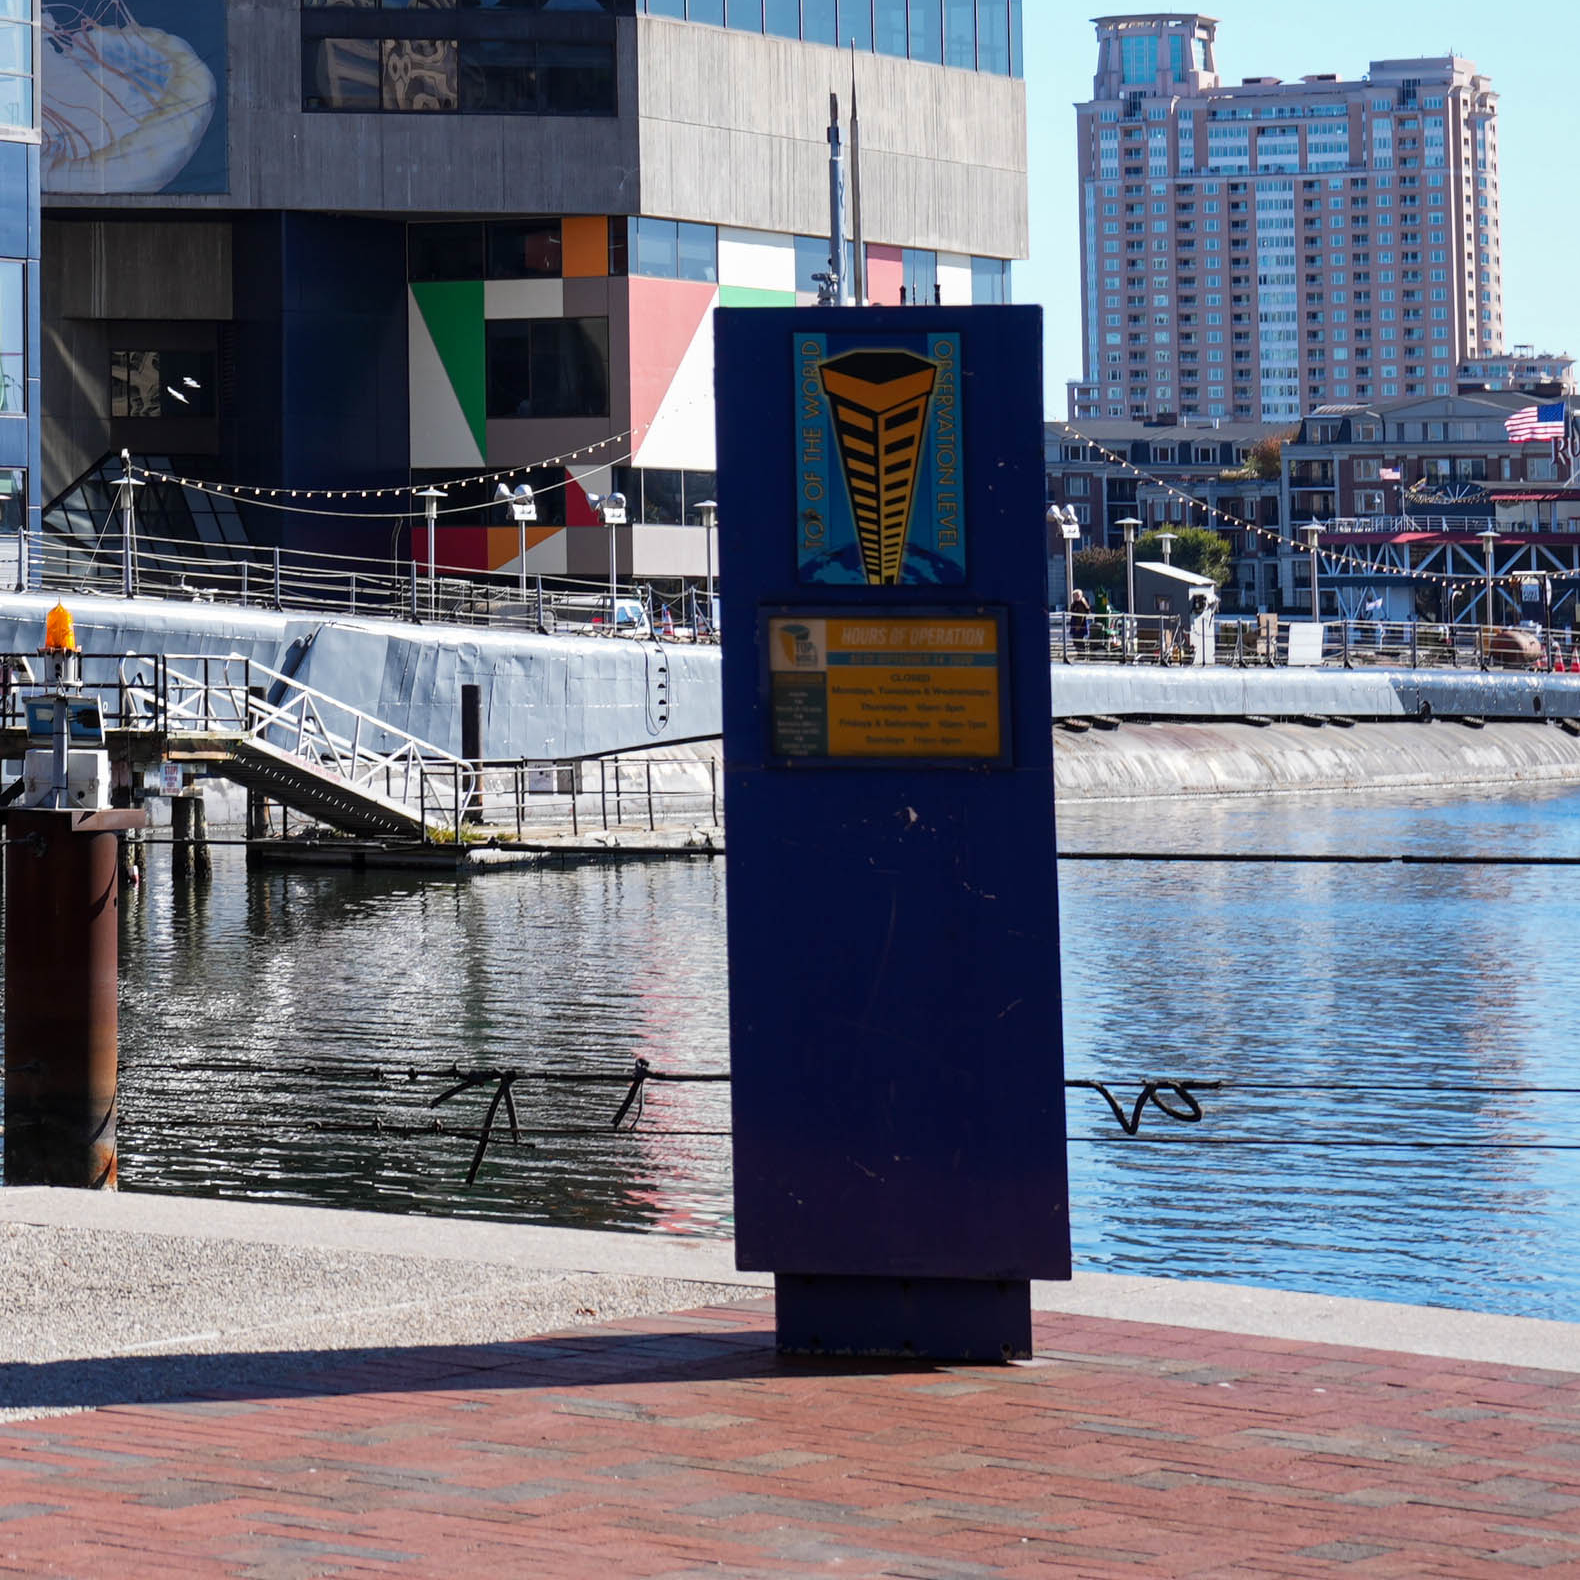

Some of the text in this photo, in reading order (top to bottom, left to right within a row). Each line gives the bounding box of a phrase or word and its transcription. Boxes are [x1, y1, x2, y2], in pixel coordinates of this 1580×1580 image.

[801, 340, 825, 550] TOP OF THE WORLD
[934, 339, 959, 550] OBSERVATION LEVEL
[841, 626, 985, 647] HOURS OF OPERATION
